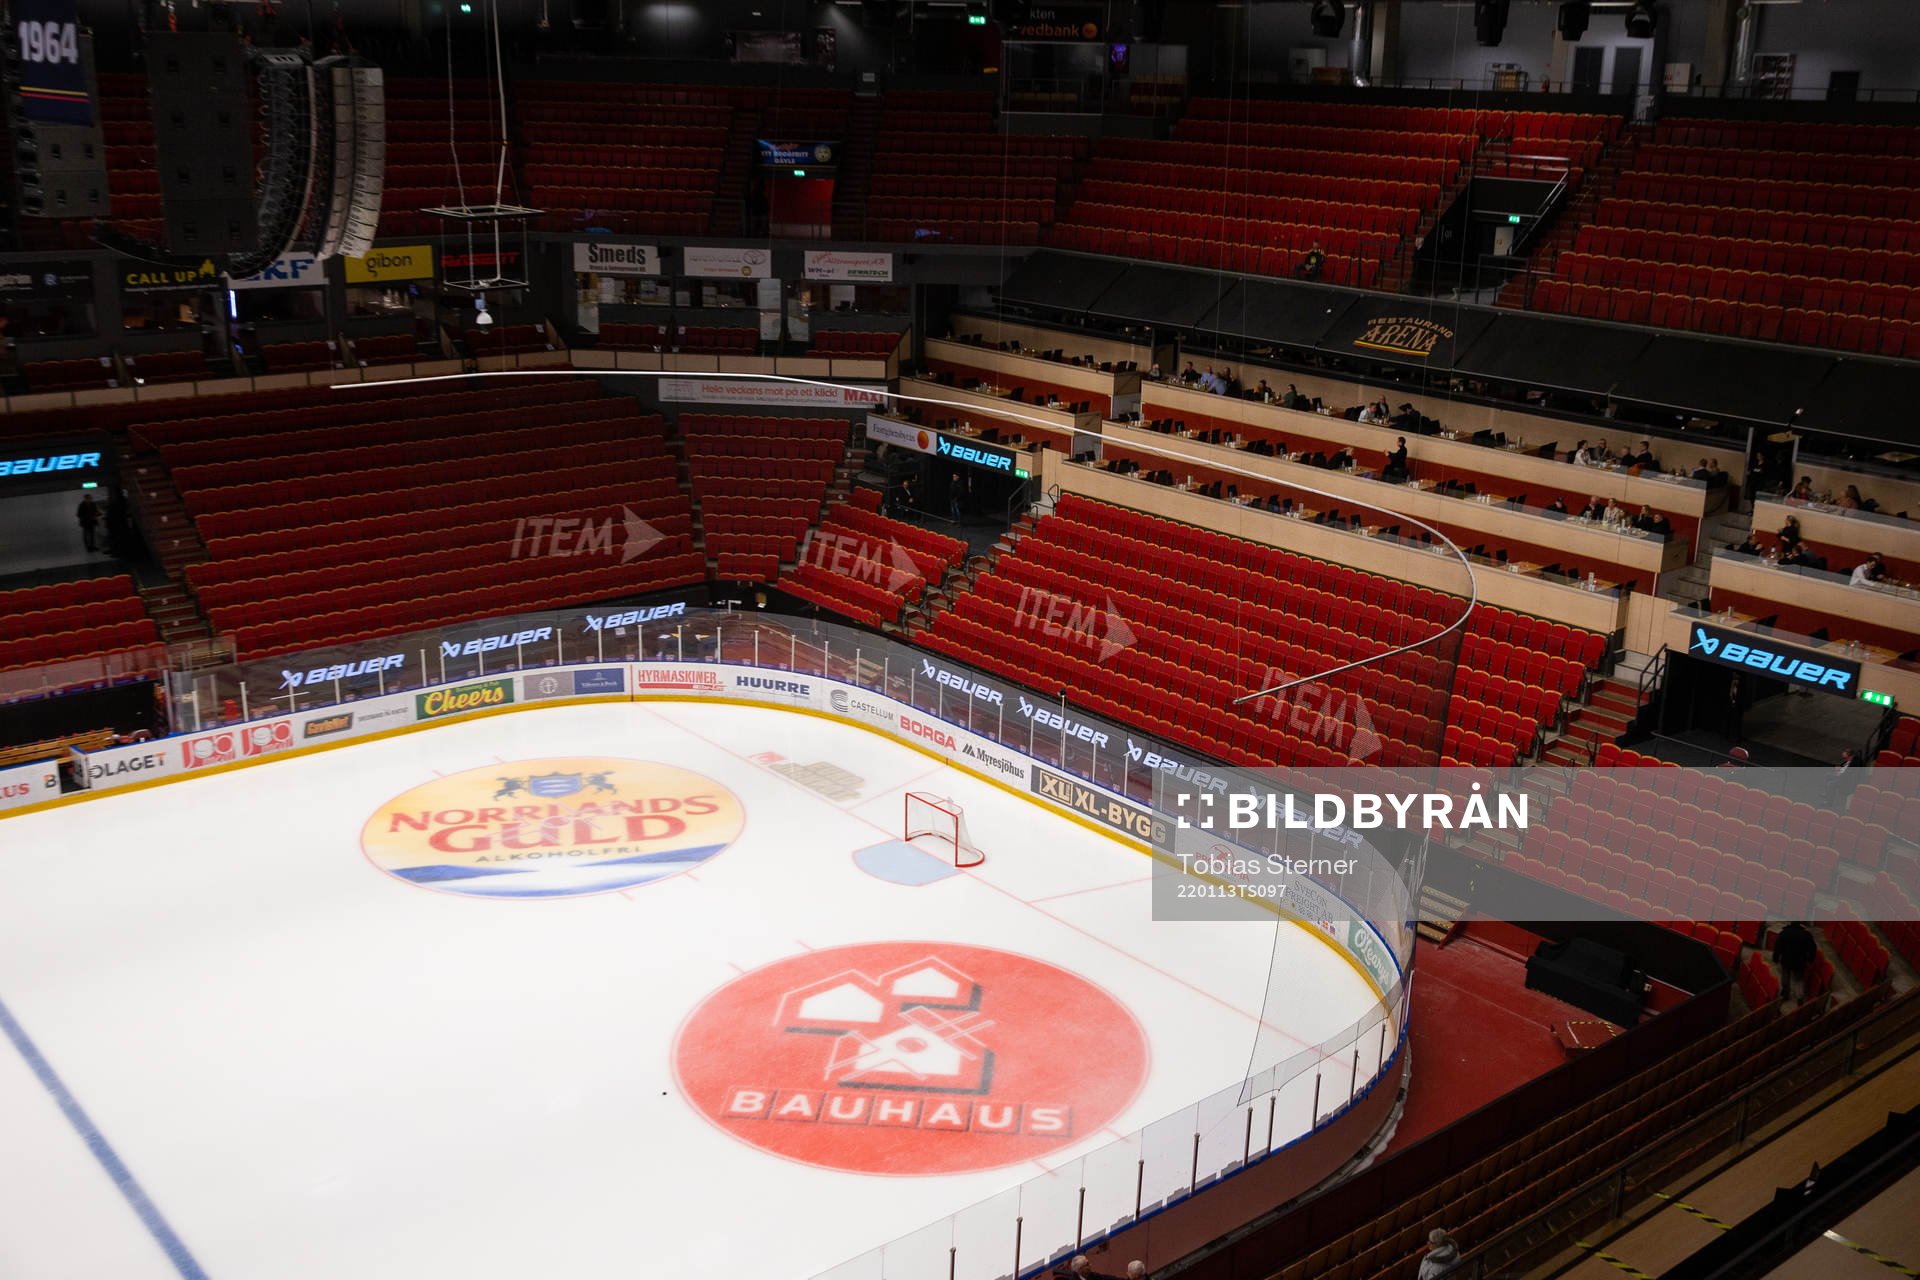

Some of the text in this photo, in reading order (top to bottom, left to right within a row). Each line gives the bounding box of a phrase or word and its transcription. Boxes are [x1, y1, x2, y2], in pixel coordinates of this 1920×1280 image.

[17, 20, 79, 65] 1964
[1019, 22, 1080, 38] edbank
[246, 258, 315, 281] KF
[366, 254, 413, 278] gibon
[588, 244, 646, 265] Smeds
[126, 271, 197, 286] CALL UP
[1360, 324, 1439, 352] ARENA
[1367, 316, 1455, 339] RESTAURANG
[702, 384, 724, 394] Hela
[726, 385, 764, 396] veckans
[765, 387, 784, 397] mat
[800, 389, 813, 398] ett
[951, 445, 1012, 471] BAUER
[510, 516, 613, 559] ITEM
[798, 529, 885, 583] ITEM
[605, 602, 687, 629] BAUER
[1014, 587, 1096, 649] ITEM
[462, 626, 553, 656] BAUER
[303, 653, 405, 685] BAUER
[638, 669, 717, 684] HYRMASKINER
[1719, 642, 1851, 690] BAUER
[424, 684, 505, 716] Cheers
[736, 675, 811, 696] HUURRE
[936, 670, 1004, 706] BAUER
[851, 699, 894, 721] CASTELLUM
[1255, 667, 1350, 748] ITEM
[899, 714, 957, 752] BORGA
[1033, 708, 1109, 749] BAUER
[976, 747, 1025, 779] Myresjöhus
[1143, 752, 1229, 796] BAUER
[387, 795, 721, 834] NORRLANDS
[1074, 787, 1167, 844] XL-BYGG
[428, 814, 688, 854] GULD
[476, 844, 642, 865] ALKOHOLFRI
[729, 1089, 1067, 1132] BAUHAUS
